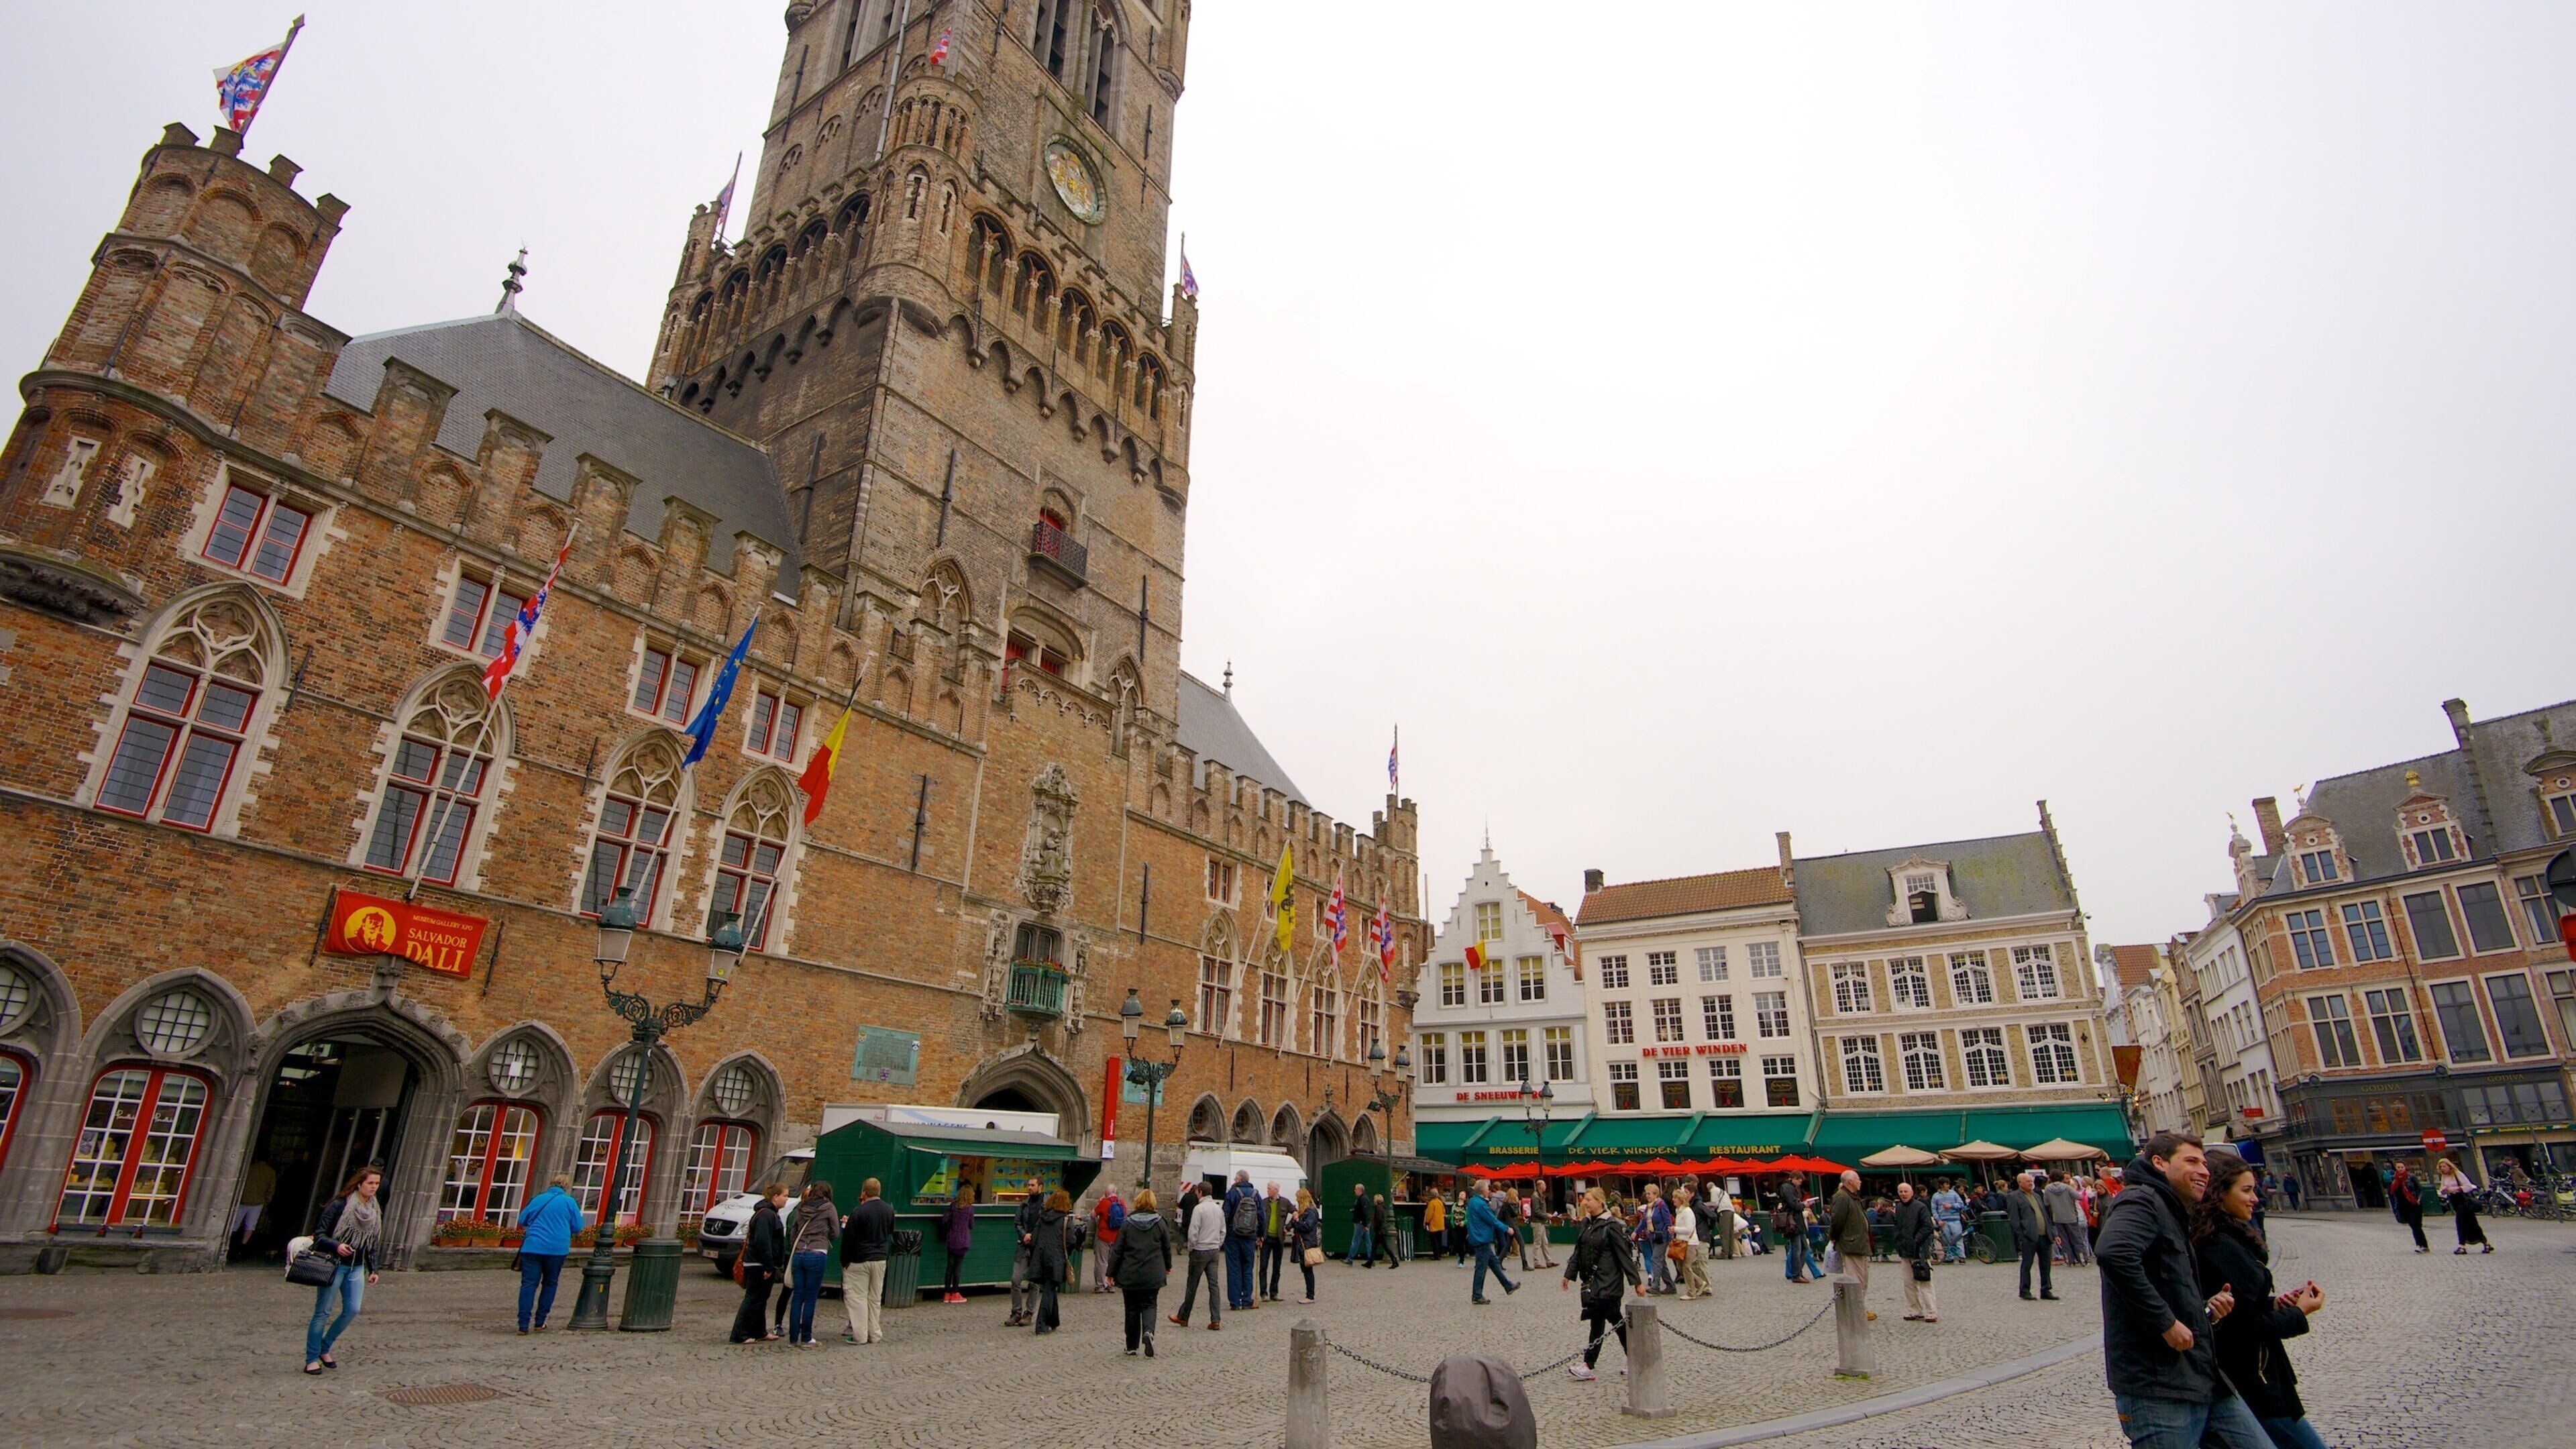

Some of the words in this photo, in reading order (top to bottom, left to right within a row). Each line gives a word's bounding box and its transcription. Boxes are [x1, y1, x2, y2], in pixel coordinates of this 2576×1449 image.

[413, 915, 435, 925] MUSEUM
[435, 920, 462, 928] GALLERY
[408, 928, 468, 948] SALVADOR
[405, 941, 464, 972] DALI
[1642, 1048, 1658, 1057] DE
[1662, 1046, 1690, 1056] VIER
[1695, 1044, 1748, 1055] WINDEN
[2487, 1074, 2525, 1082] GODIVA
[2361, 1084, 2400, 1092] GODIVA
[1489, 1146, 1539, 1155] BRASSERIE
[1589, 1146, 1620, 1155] VIER
[1709, 1145, 1781, 1154] RESTAURANT
